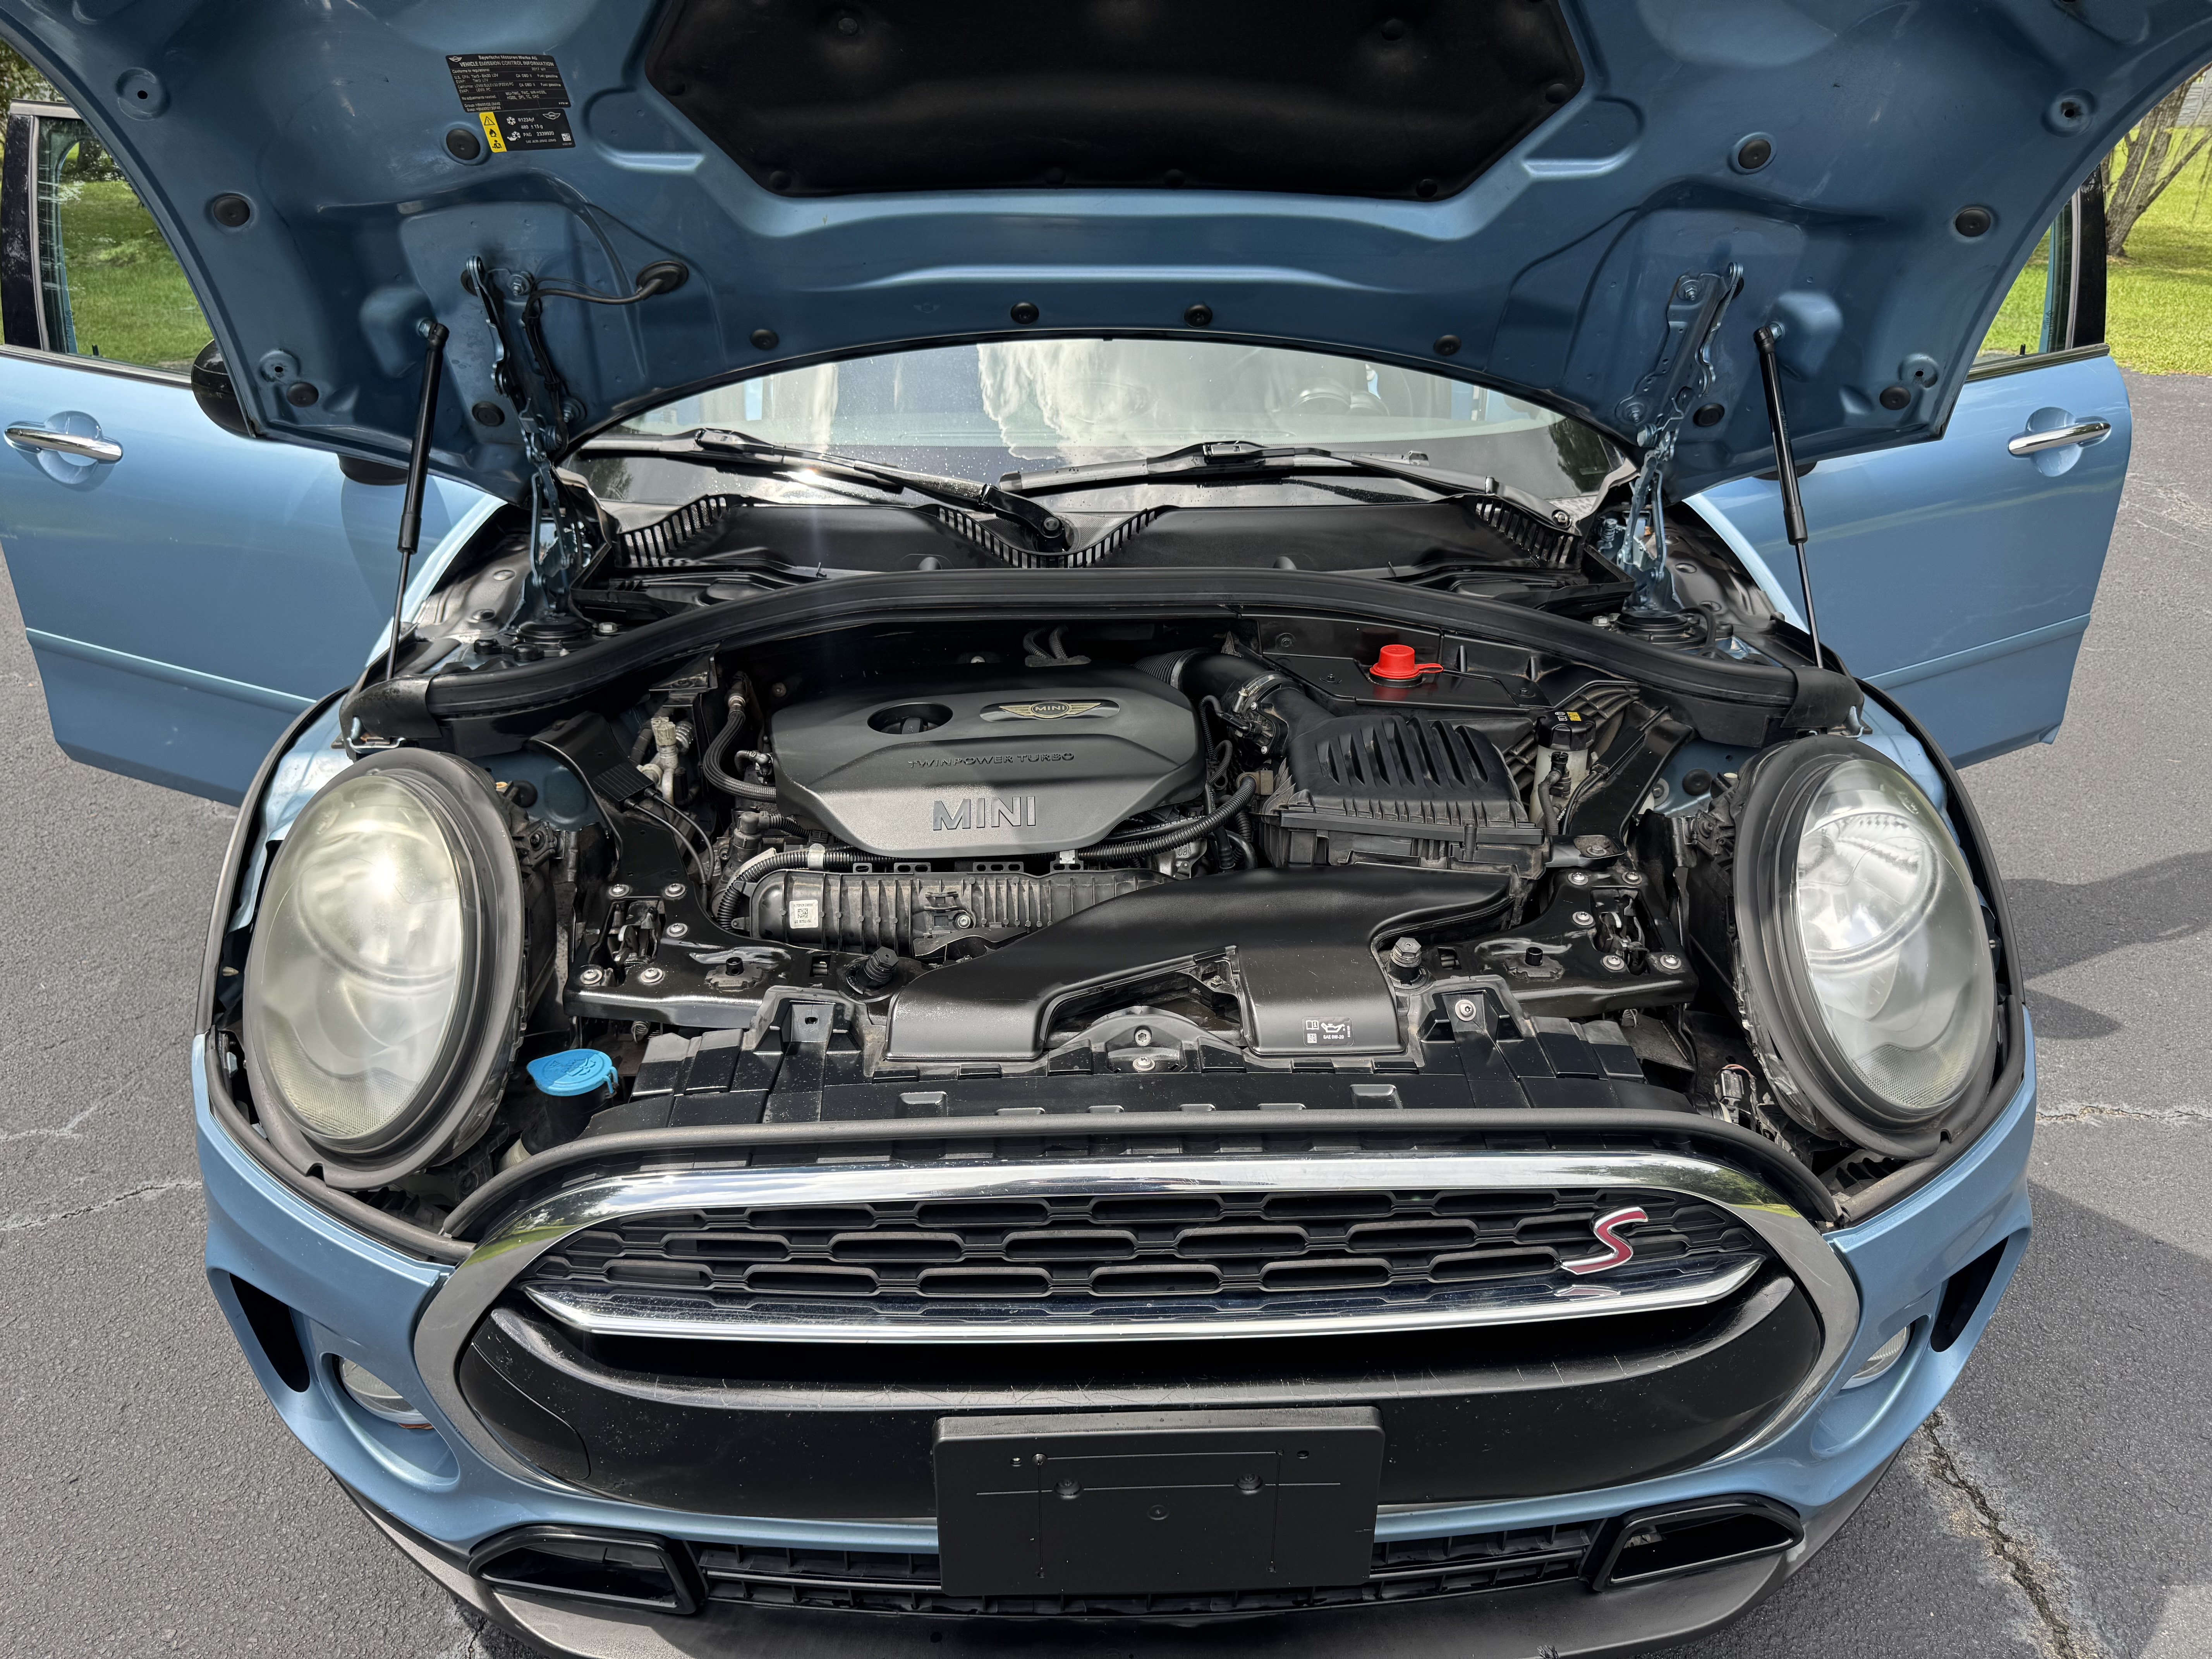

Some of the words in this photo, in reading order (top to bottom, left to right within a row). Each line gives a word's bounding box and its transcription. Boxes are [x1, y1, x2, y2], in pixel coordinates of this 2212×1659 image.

[907, 755, 1014, 768] TWINPOWER
[1017, 752, 1075, 763] TURBO
[933, 796, 1036, 831] MINI
[1558, 1205, 1649, 1275] S
